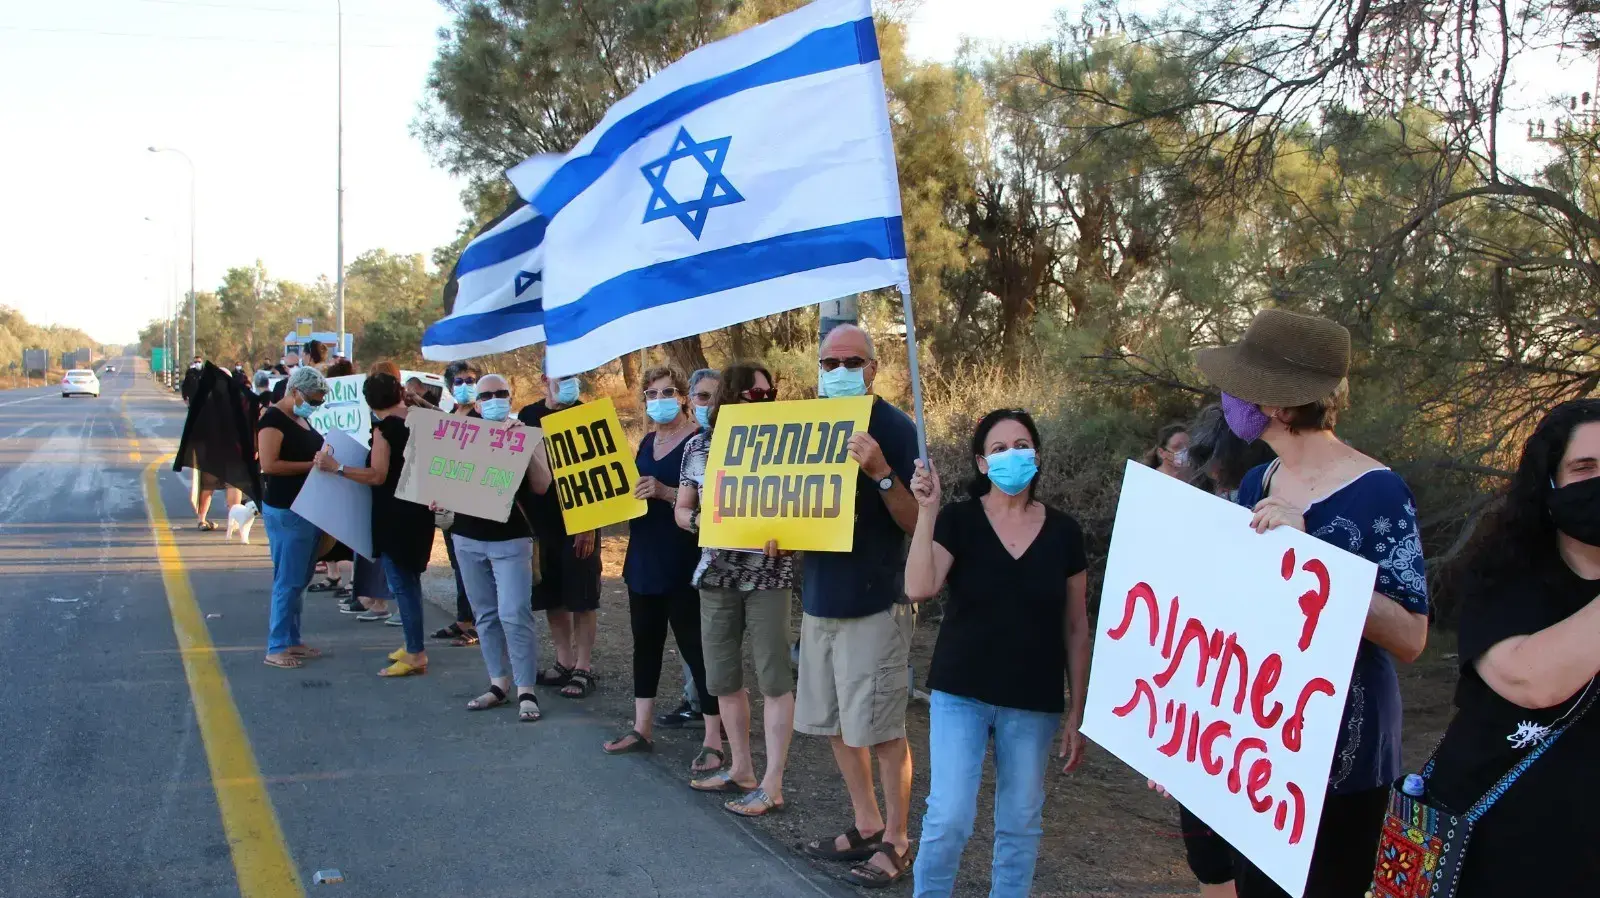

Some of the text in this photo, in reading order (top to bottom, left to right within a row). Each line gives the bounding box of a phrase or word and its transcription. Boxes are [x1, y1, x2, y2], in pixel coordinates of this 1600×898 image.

[557, 461, 630, 511] נמאס
[723, 420, 855, 473] מנותקים
[1106, 581, 1336, 753] לשחיתות
[1112, 678, 1306, 845] השלטונית
